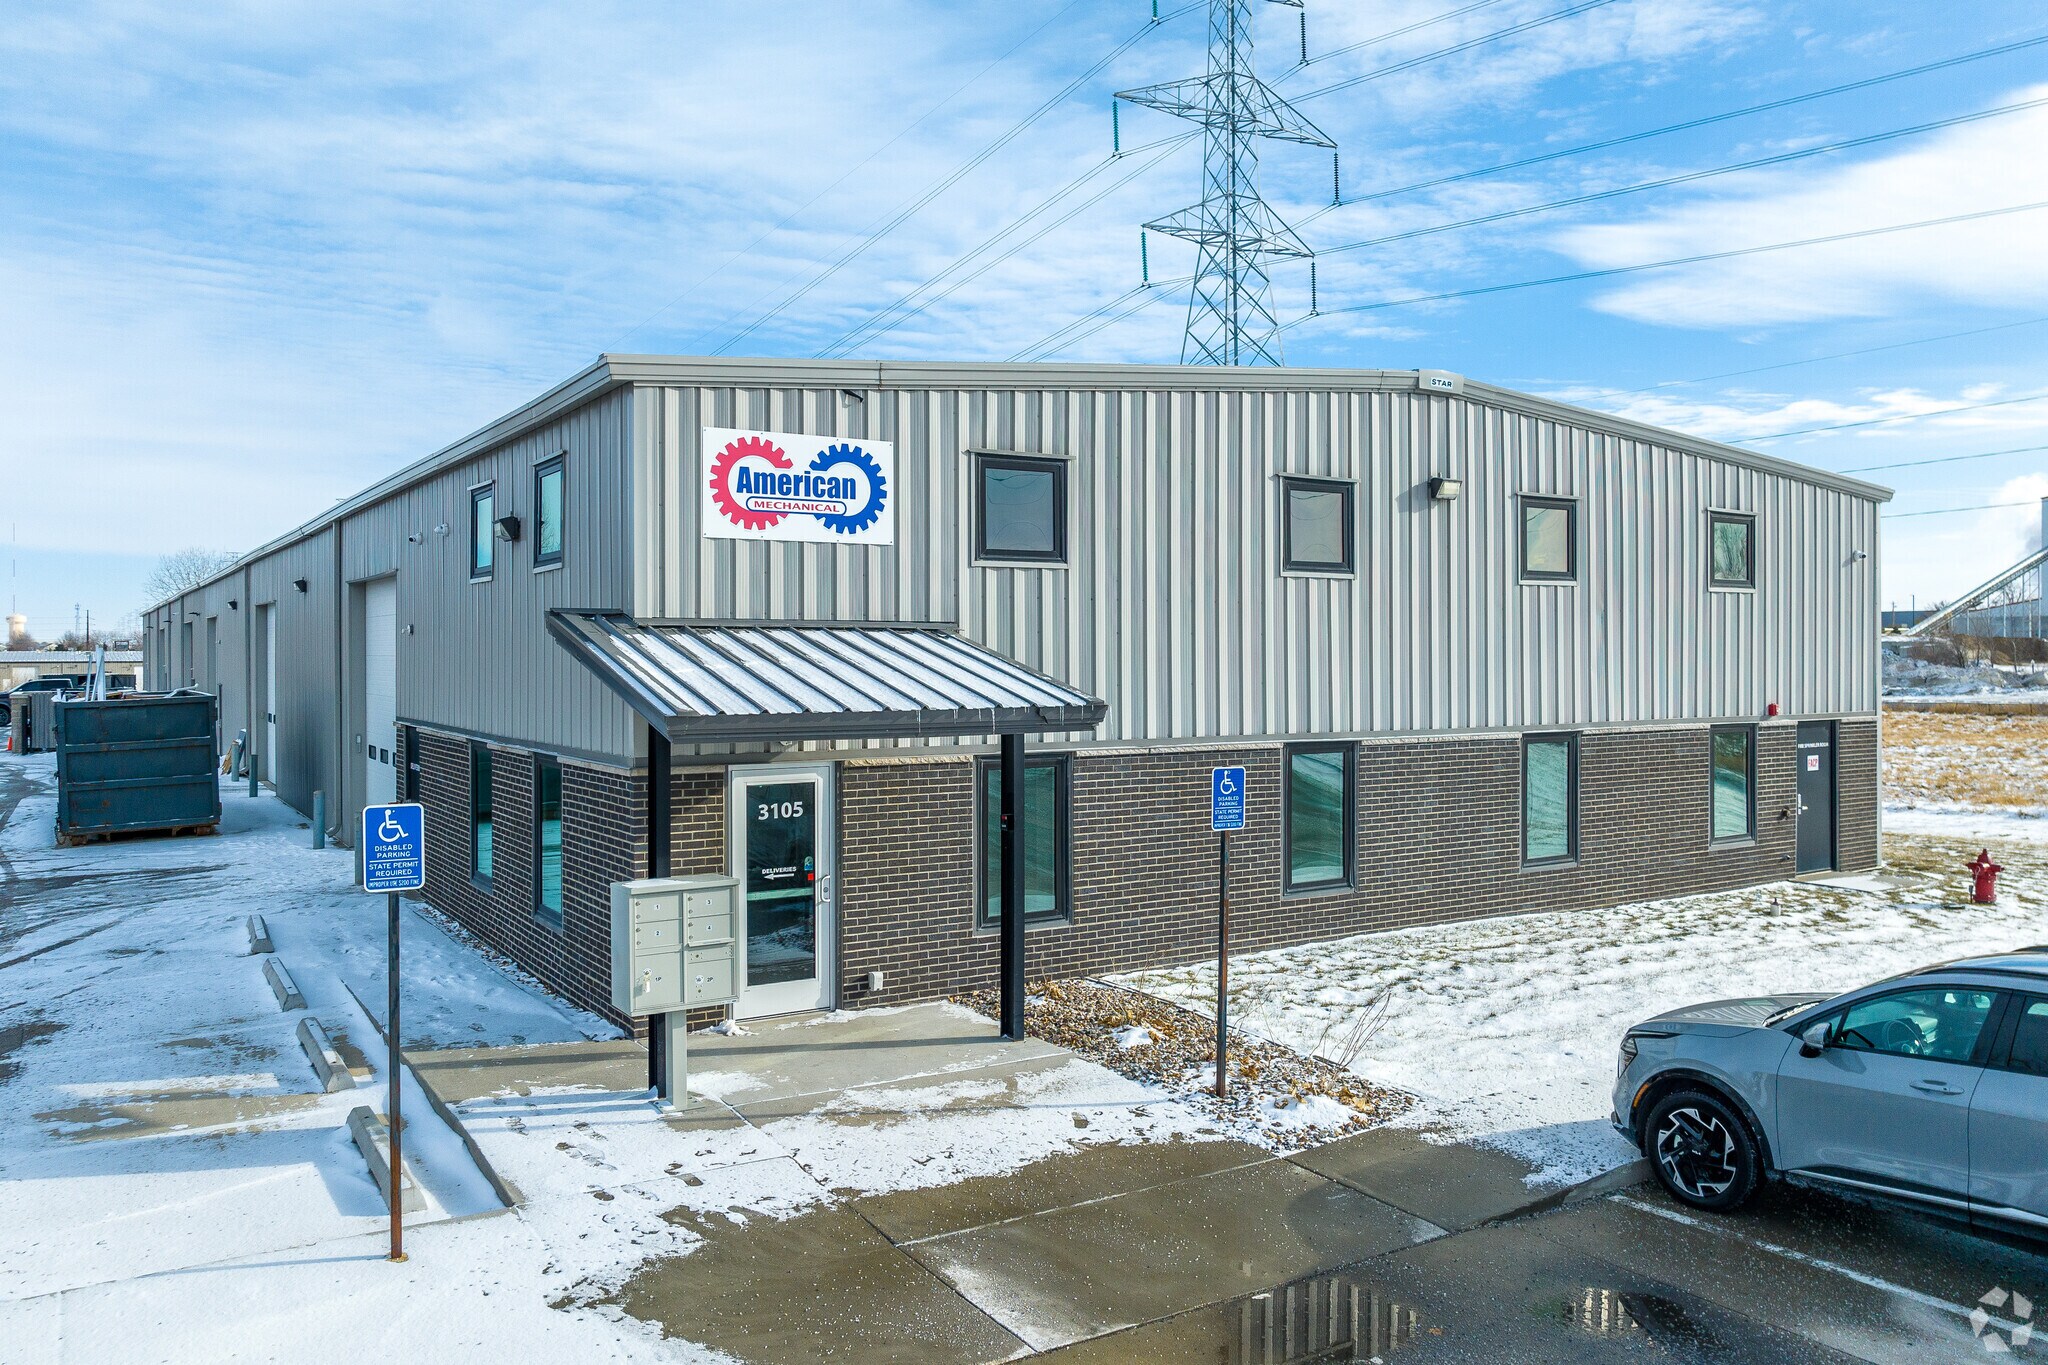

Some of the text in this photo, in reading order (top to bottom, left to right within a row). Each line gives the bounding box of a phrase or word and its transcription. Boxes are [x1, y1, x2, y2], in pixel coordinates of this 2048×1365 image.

[1431, 378, 1452, 387] STAR
[736, 466, 856, 500] American
[754, 500, 840, 513] MECHANICAL
[758, 801, 804, 820] 3105
[374, 844, 413, 852] DISABLED
[377, 851, 411, 859] PARKING
[393, 861, 419, 869] PERMIT
[376, 869, 412, 877] REQUIRED
[762, 866, 797, 875] DELIVERIES
